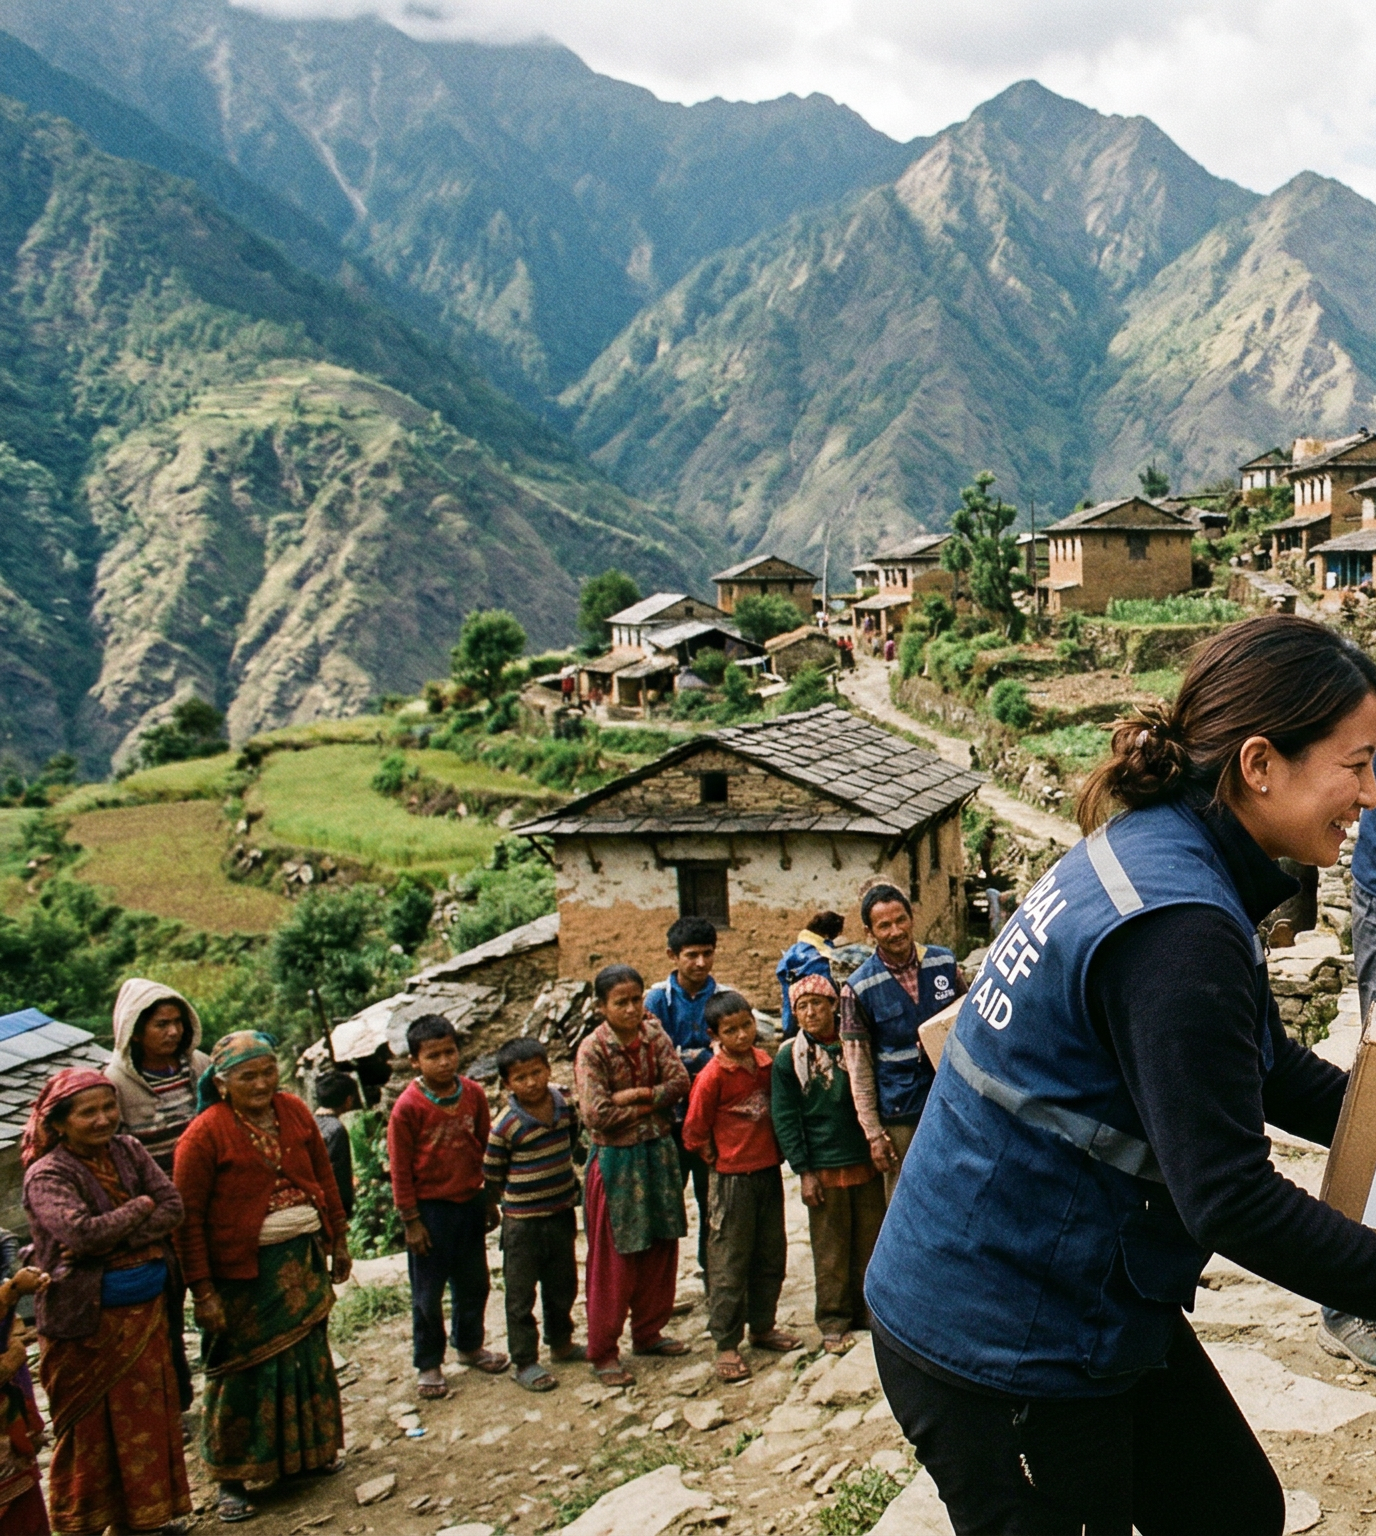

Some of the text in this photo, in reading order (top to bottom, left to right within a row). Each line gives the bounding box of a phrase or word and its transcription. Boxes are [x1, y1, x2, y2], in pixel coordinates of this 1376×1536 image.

[1024, 859, 1067, 946] BAL
[990, 922, 1040, 985] IEF
[971, 977, 1013, 1031] AID
